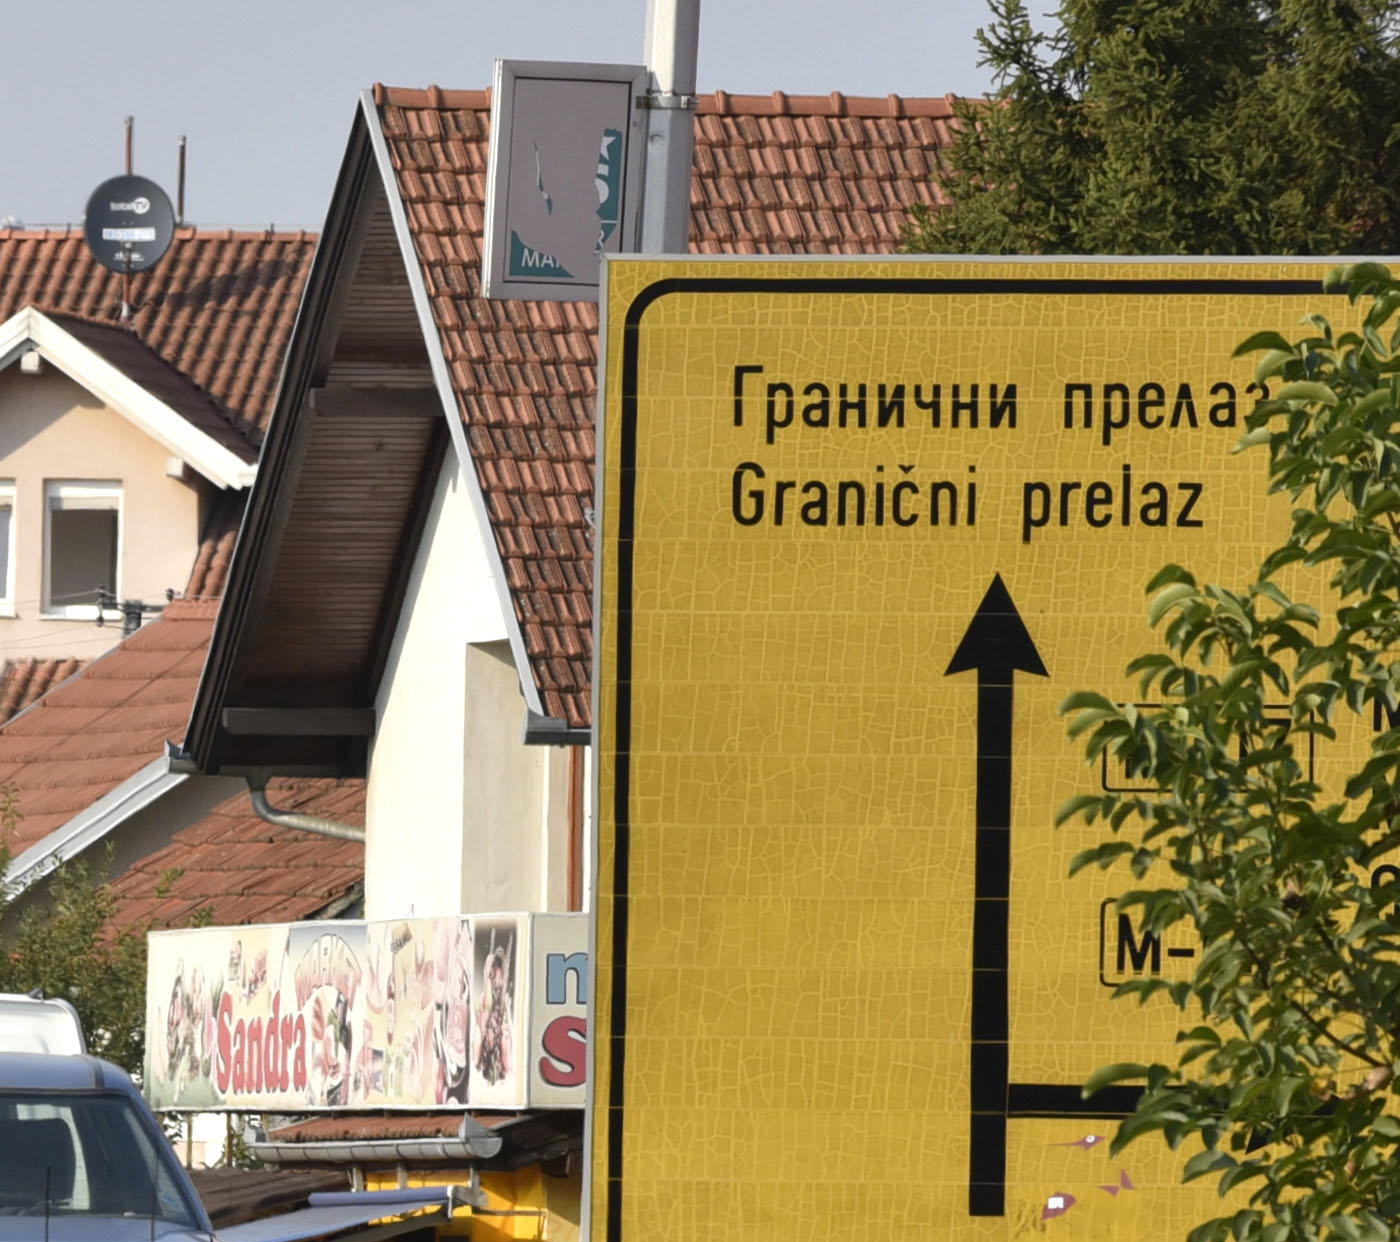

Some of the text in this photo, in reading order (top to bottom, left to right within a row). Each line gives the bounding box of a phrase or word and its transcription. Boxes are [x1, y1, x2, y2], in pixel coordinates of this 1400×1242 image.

[733, 364, 1018, 445] Гранични
[731, 462, 1204, 545] Granični prelaz
[216, 988, 307, 1094] Sandra
